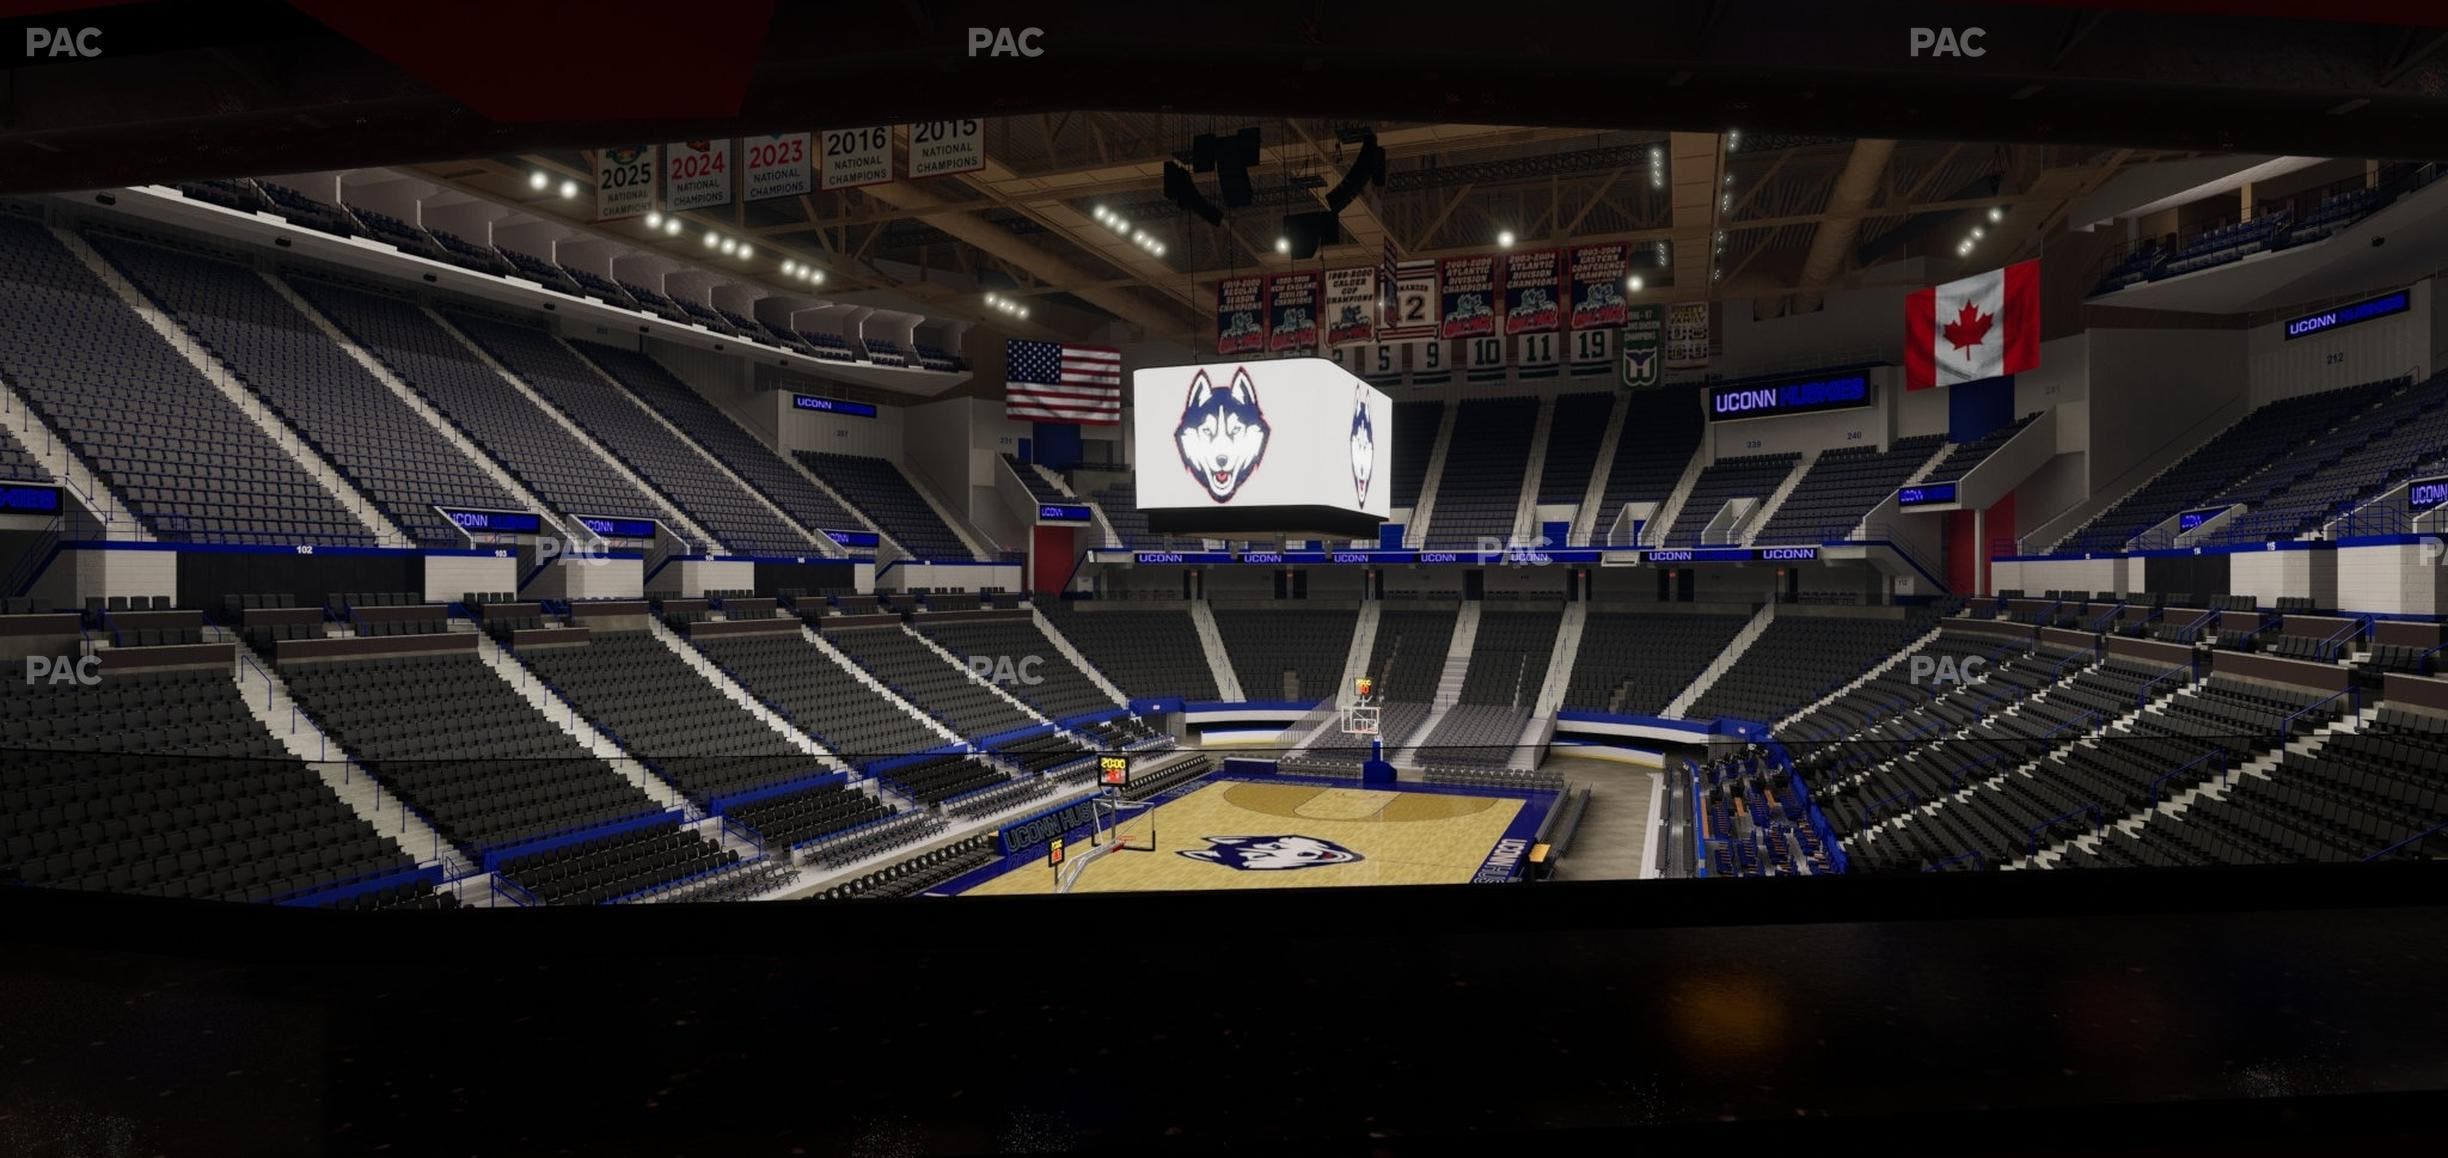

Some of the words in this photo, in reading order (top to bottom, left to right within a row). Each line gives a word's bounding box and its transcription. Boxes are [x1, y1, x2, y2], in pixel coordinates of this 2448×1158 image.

[915, 120, 978, 144] 2015
[828, 128, 886, 156] 2016
[749, 140, 802, 169] 2023
[922, 143, 973, 157] NATIONAL
[672, 151, 725, 180] 2024
[834, 156, 883, 170] NATIONAL
[916, 156, 978, 173] CHAMPIONS
[602, 163, 651, 189] 2025
[753, 170, 800, 183] NATIONAL
[829, 169, 887, 185] CHAMPIONS
[677, 179, 720, 192] NATIONAL
[750, 182, 804, 197] CHAMPIONS
[608, 190, 649, 202] NATIONAL
[674, 191, 724, 206] CHAMPIONS
[2290, 313, 2336, 334] UCONN
[1527, 335, 1551, 361] 11
[1579, 331, 1605, 358] 19
[1378, 346, 1390, 371] 5
[1427, 343, 1438, 368] 9
[1475, 339, 1499, 365] 10
[2327, 353, 2344, 365] 212
[797, 398, 832, 410] UCONN
[1716, 388, 1776, 412] UCONN
[1847, 431, 1861, 440] 240
[2412, 484, 2448, 504] UCONN
[584, 520, 614, 532] CONN
[296, 545, 313, 554] 102
[1649, 551, 1692, 561] UCONN
[1763, 549, 1814, 559] UCONN
[1139, 554, 1182, 562] UCONN
[1244, 554, 1282, 563] UCONN
[1334, 554, 1368, 563] UCONN
[1421, 553, 1456, 562] UCONN
[1511, 553, 1548, 561] UCONN
[1101, 758, 1125, 768] 20:00
[1005, 814, 1061, 850] UCONN
